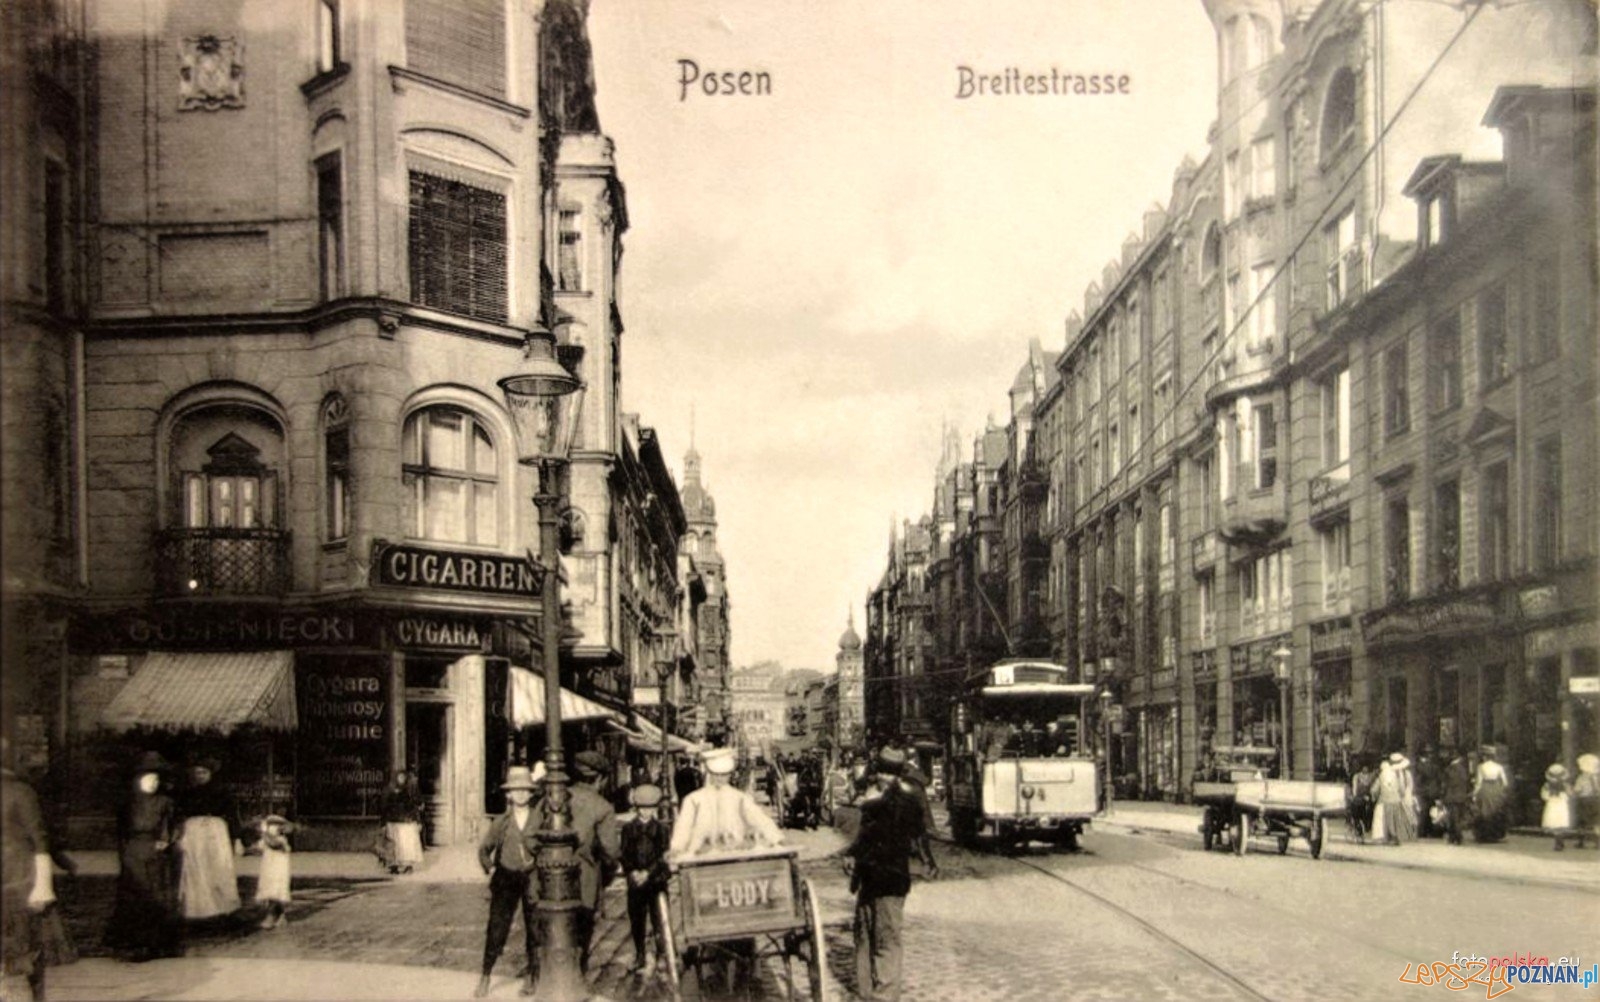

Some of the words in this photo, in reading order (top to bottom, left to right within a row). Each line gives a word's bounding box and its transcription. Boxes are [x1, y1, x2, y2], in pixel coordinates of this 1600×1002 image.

[391, 551, 542, 592] CIGARREN
[399, 618, 480, 646] CYGARA
[306, 672, 381, 697] Cygara
[716, 879, 769, 908] LODY
